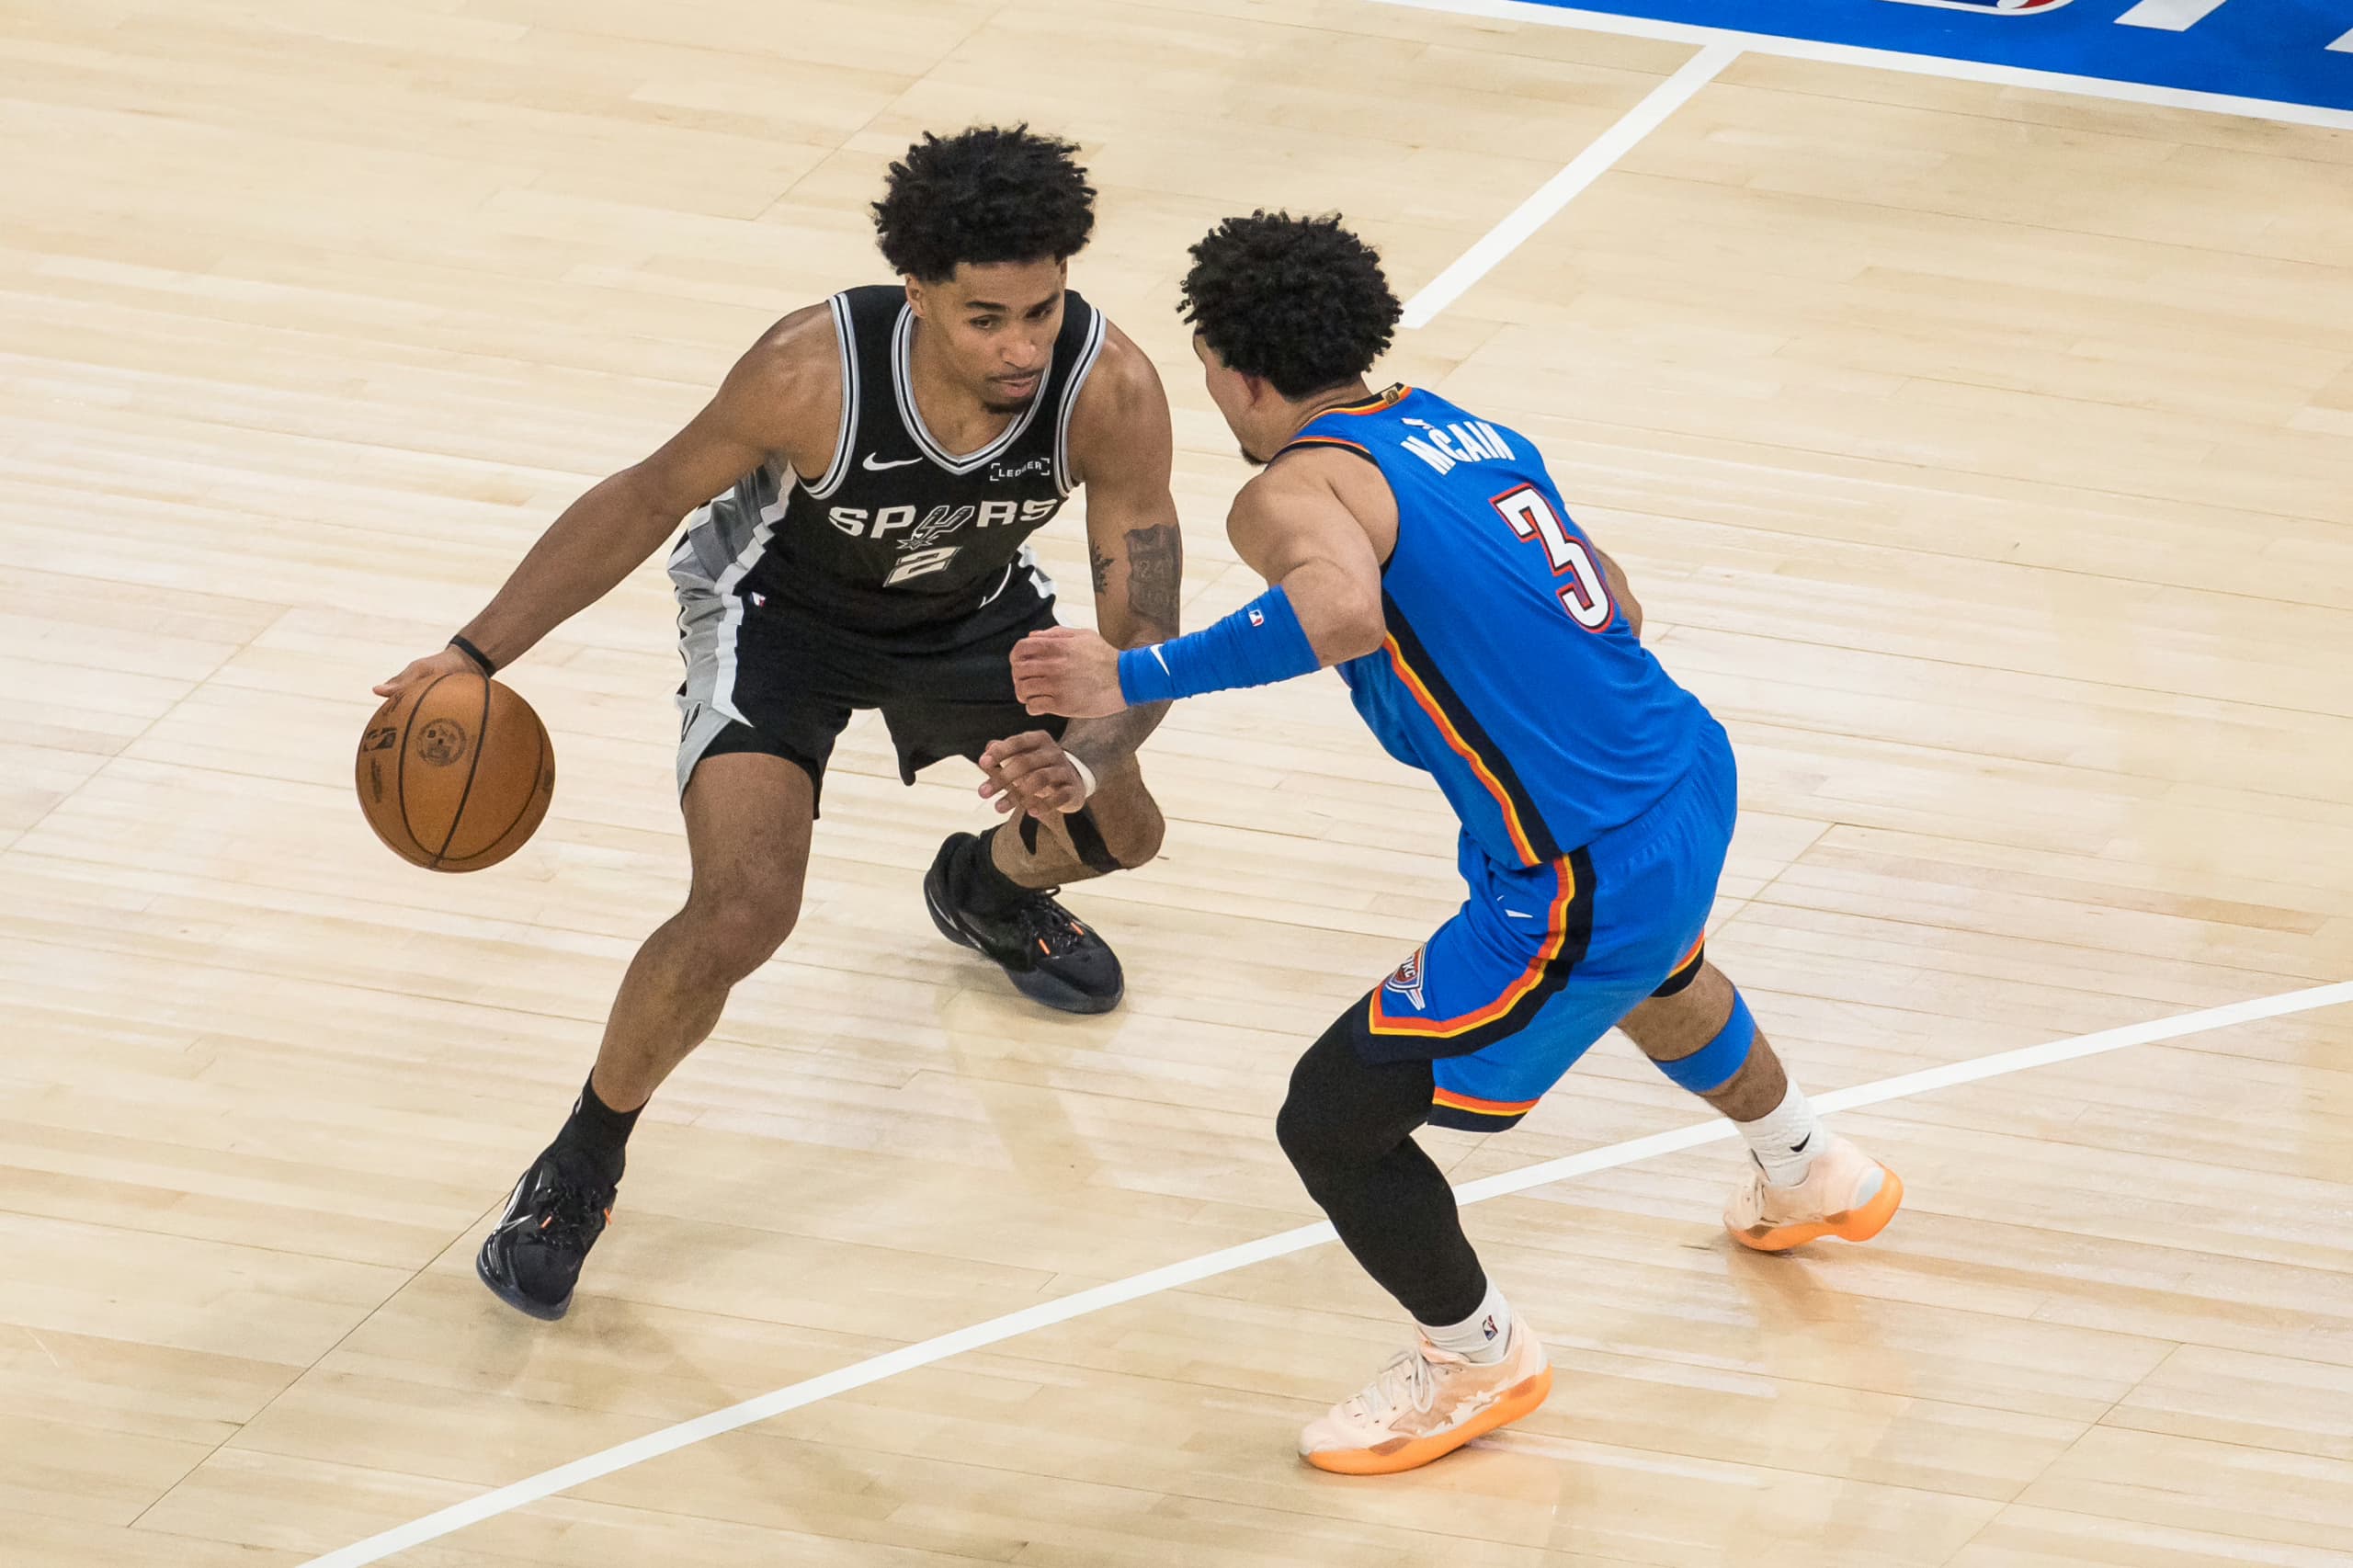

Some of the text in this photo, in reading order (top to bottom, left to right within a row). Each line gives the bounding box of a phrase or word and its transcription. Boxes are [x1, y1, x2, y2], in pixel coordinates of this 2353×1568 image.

[828, 498, 1058, 544] SPURS
[882, 546, 963, 588] 2
[1488, 482, 1615, 634] 3
